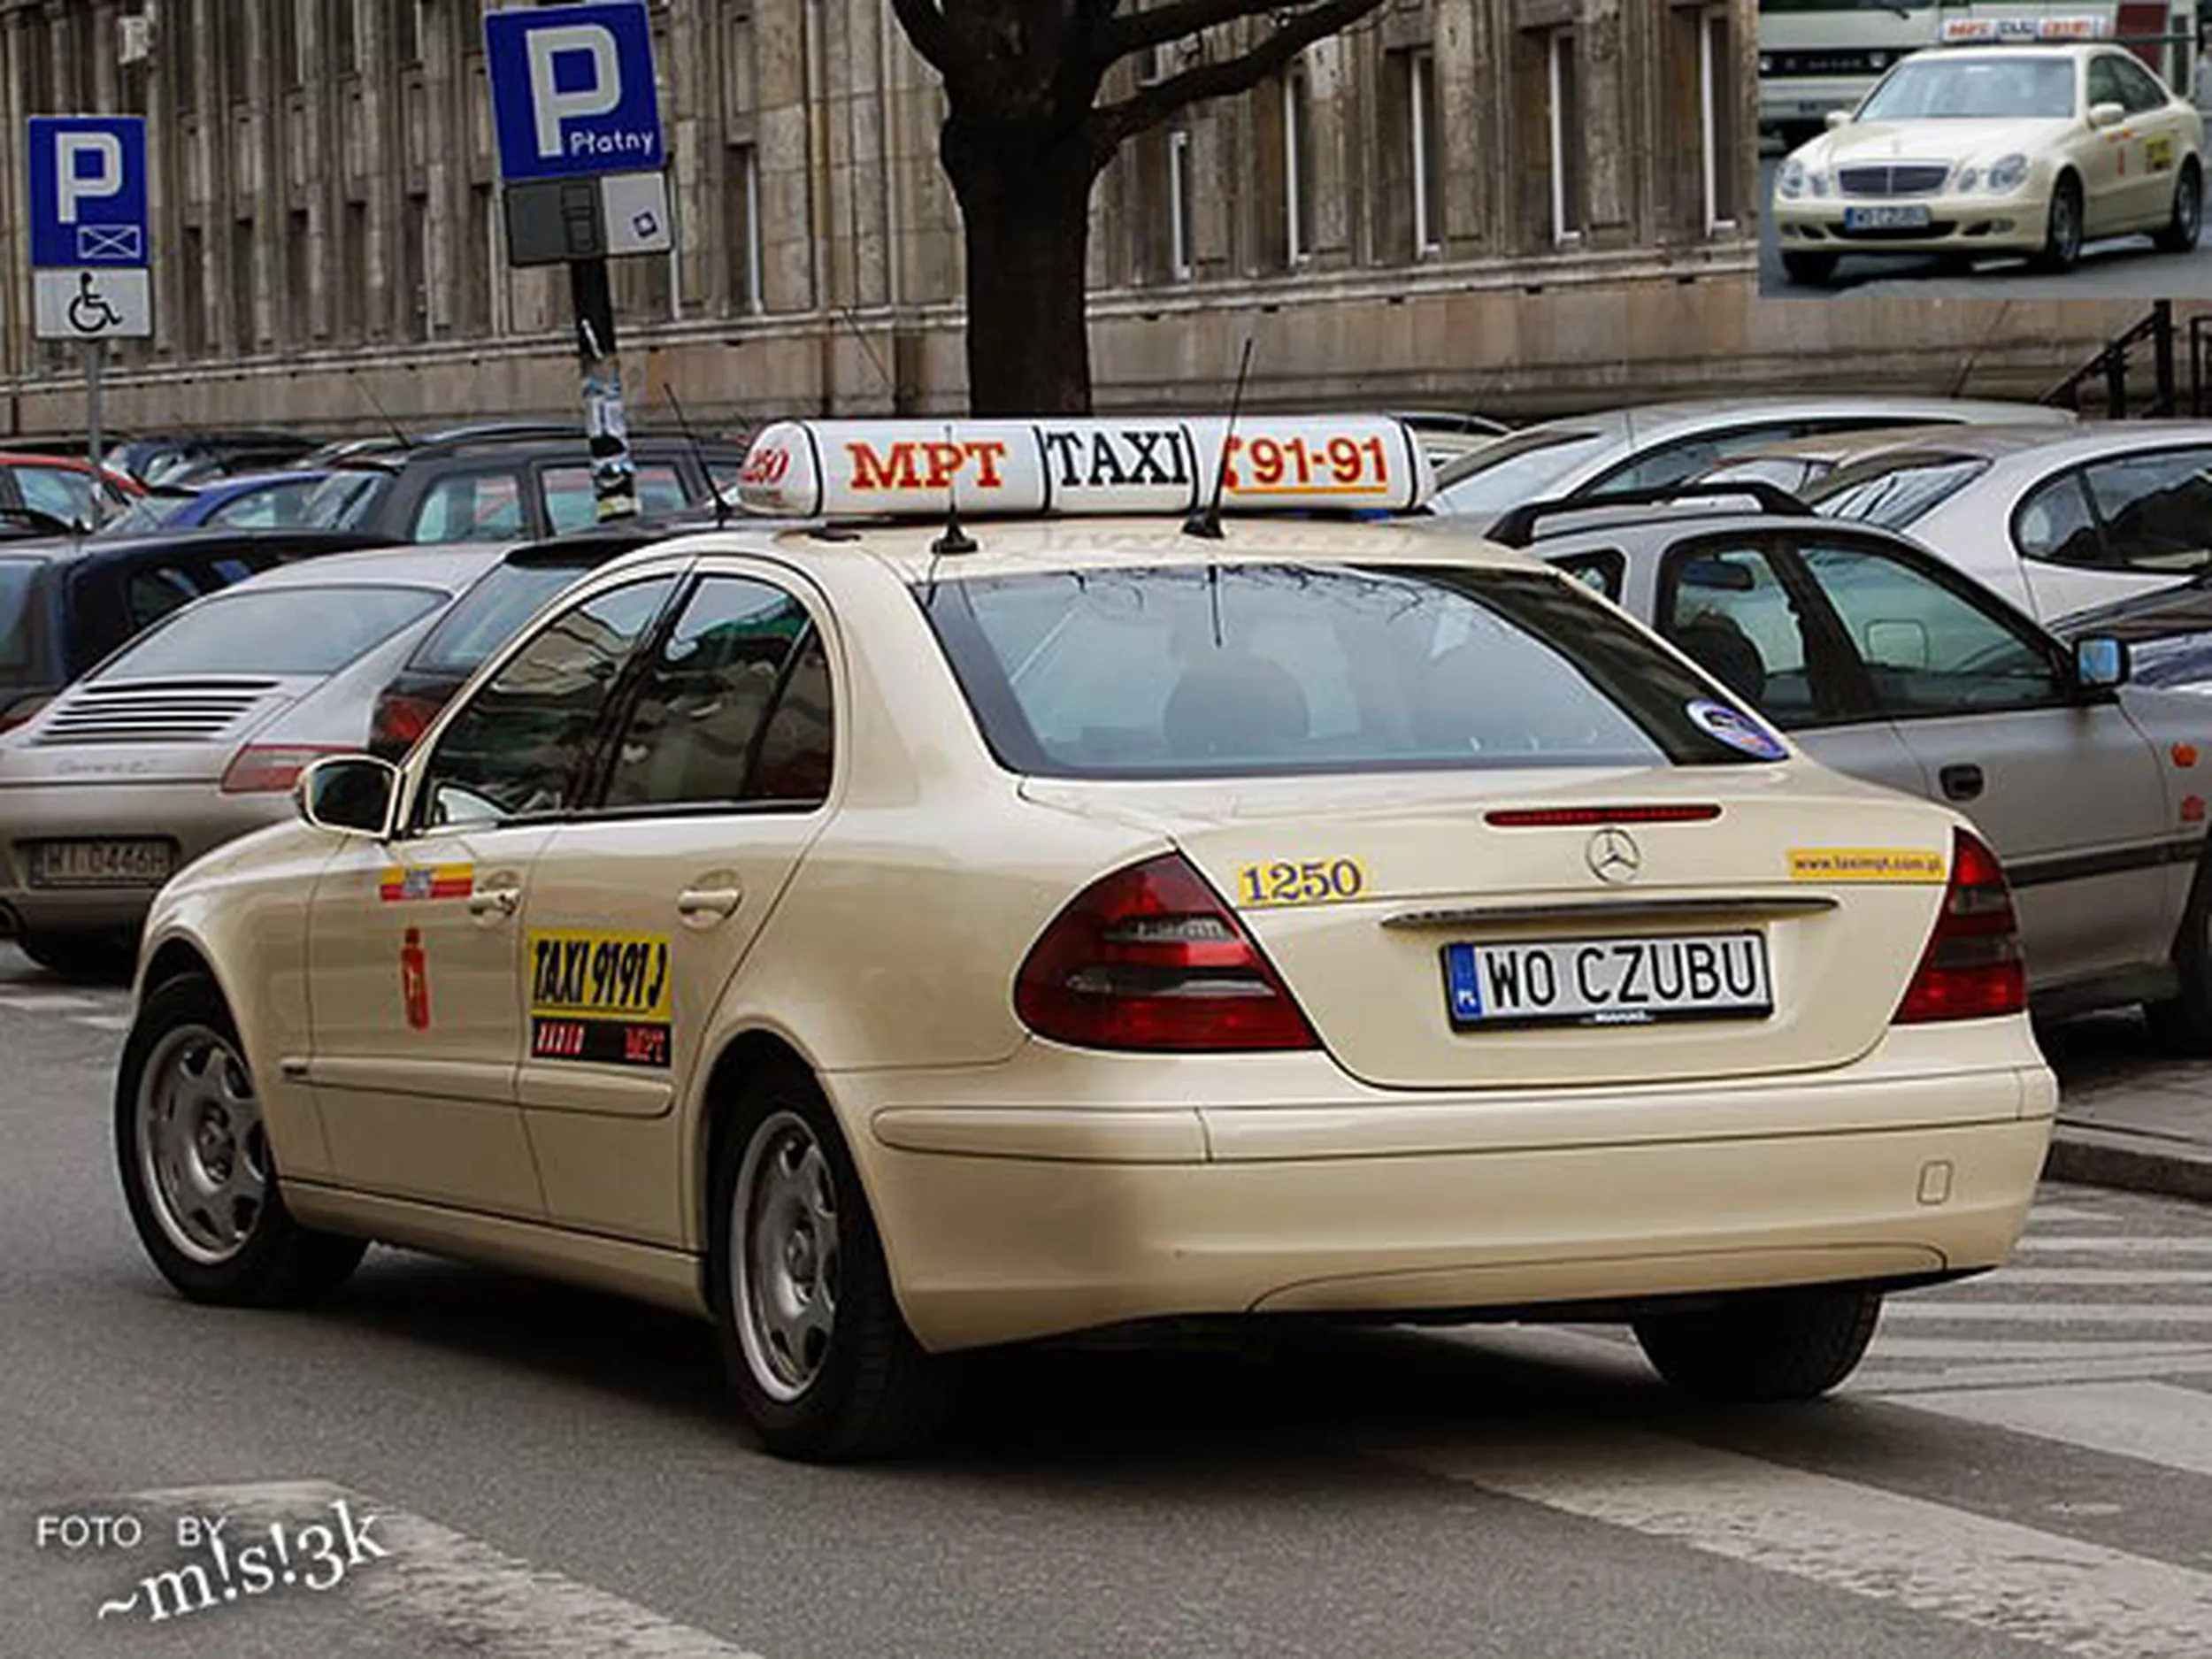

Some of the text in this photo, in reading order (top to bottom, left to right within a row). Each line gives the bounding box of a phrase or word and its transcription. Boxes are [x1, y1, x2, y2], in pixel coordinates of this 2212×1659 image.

[526, 23, 621, 157] P
[57, 132, 122, 223] P
[846, 442, 1006, 488] MPT
[1047, 430, 1188, 486] TAXI
[1249, 436, 1386, 484] 91-91
[1244, 860, 1363, 900] 1250
[534, 940, 650, 1006] TAXI 9191
[1576, 941, 1756, 1002] CZUBU
